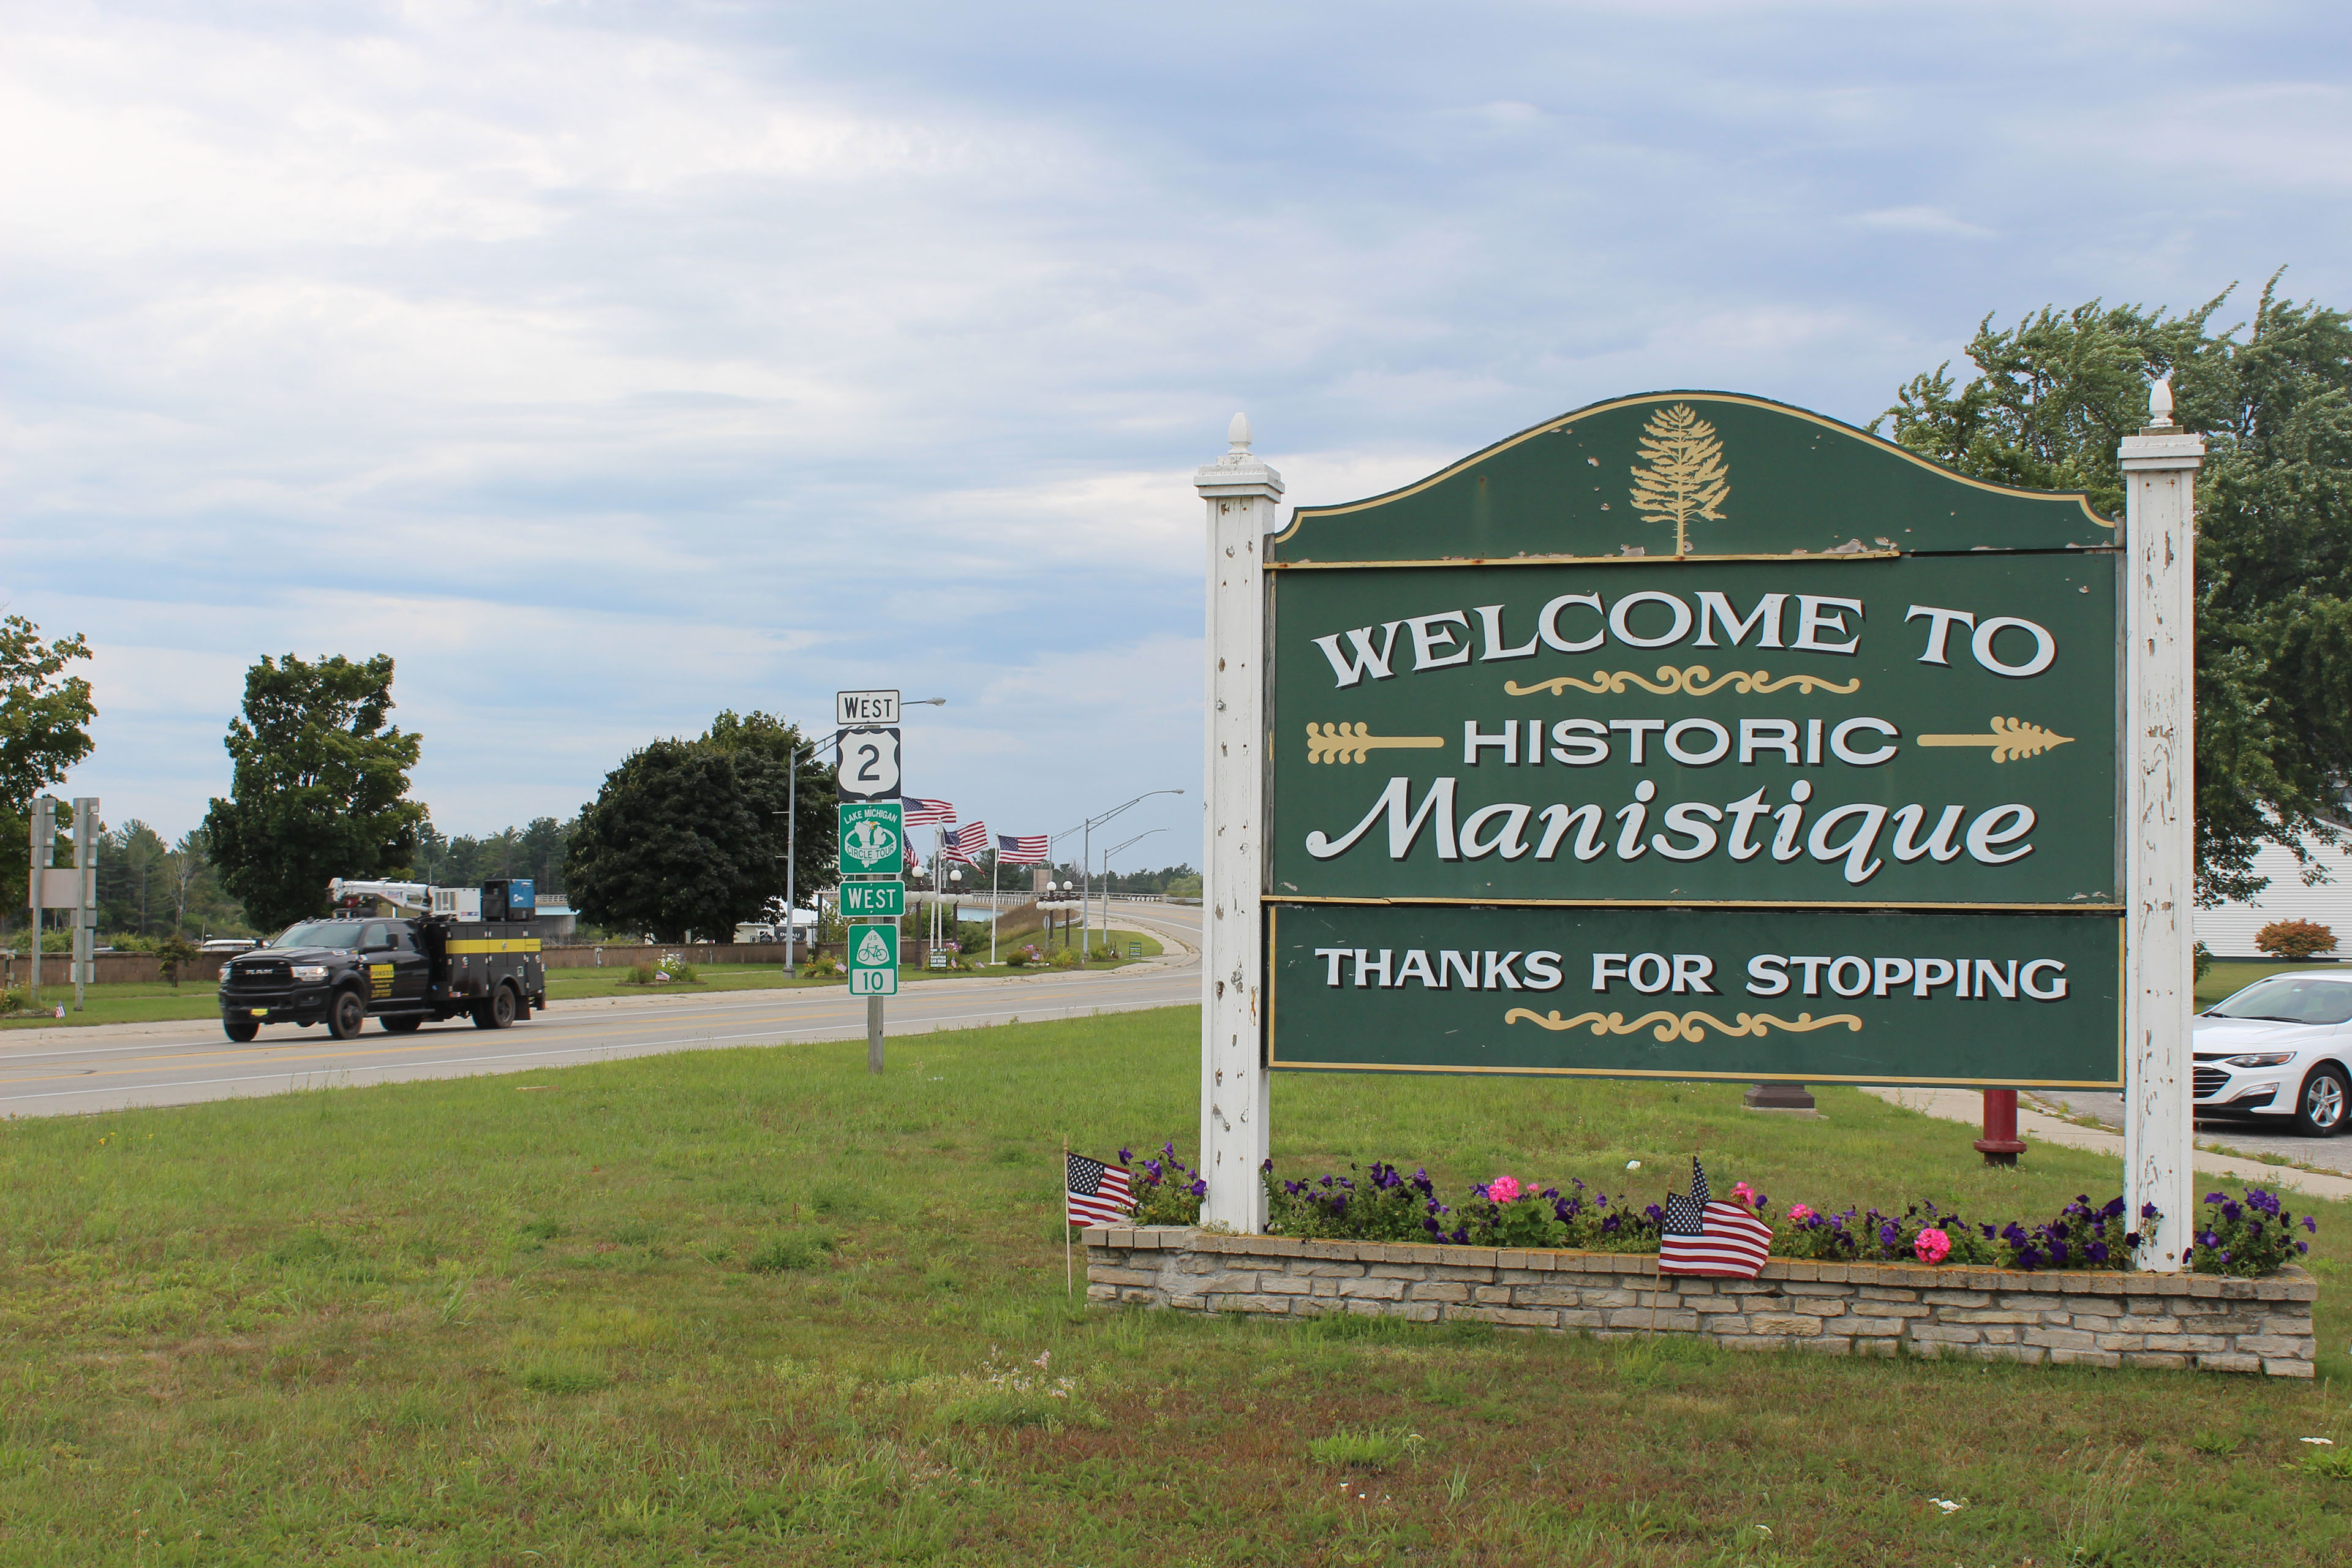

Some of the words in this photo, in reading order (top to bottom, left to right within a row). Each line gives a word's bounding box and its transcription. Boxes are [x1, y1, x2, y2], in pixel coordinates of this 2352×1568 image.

[1310, 590, 1863, 695] WELCOME
[1904, 604, 2056, 677] TO
[844, 697, 892, 718] WEST
[1463, 717, 1899, 766] HISTORIC
[858, 744, 880, 781] 2
[843, 810, 863, 824] LAKE
[864, 809, 898, 823] MICHIGAN
[1305, 777, 2035, 884] Manistique
[846, 845, 873, 859] CIRCLE
[875, 844, 894, 858] TOUR
[848, 888, 896, 909] WEST
[862, 971, 884, 990] 10
[1314, 948, 1562, 990] THANKS
[1591, 952, 1714, 993] FOR
[1746, 954, 2067, 1000] STOPPING
